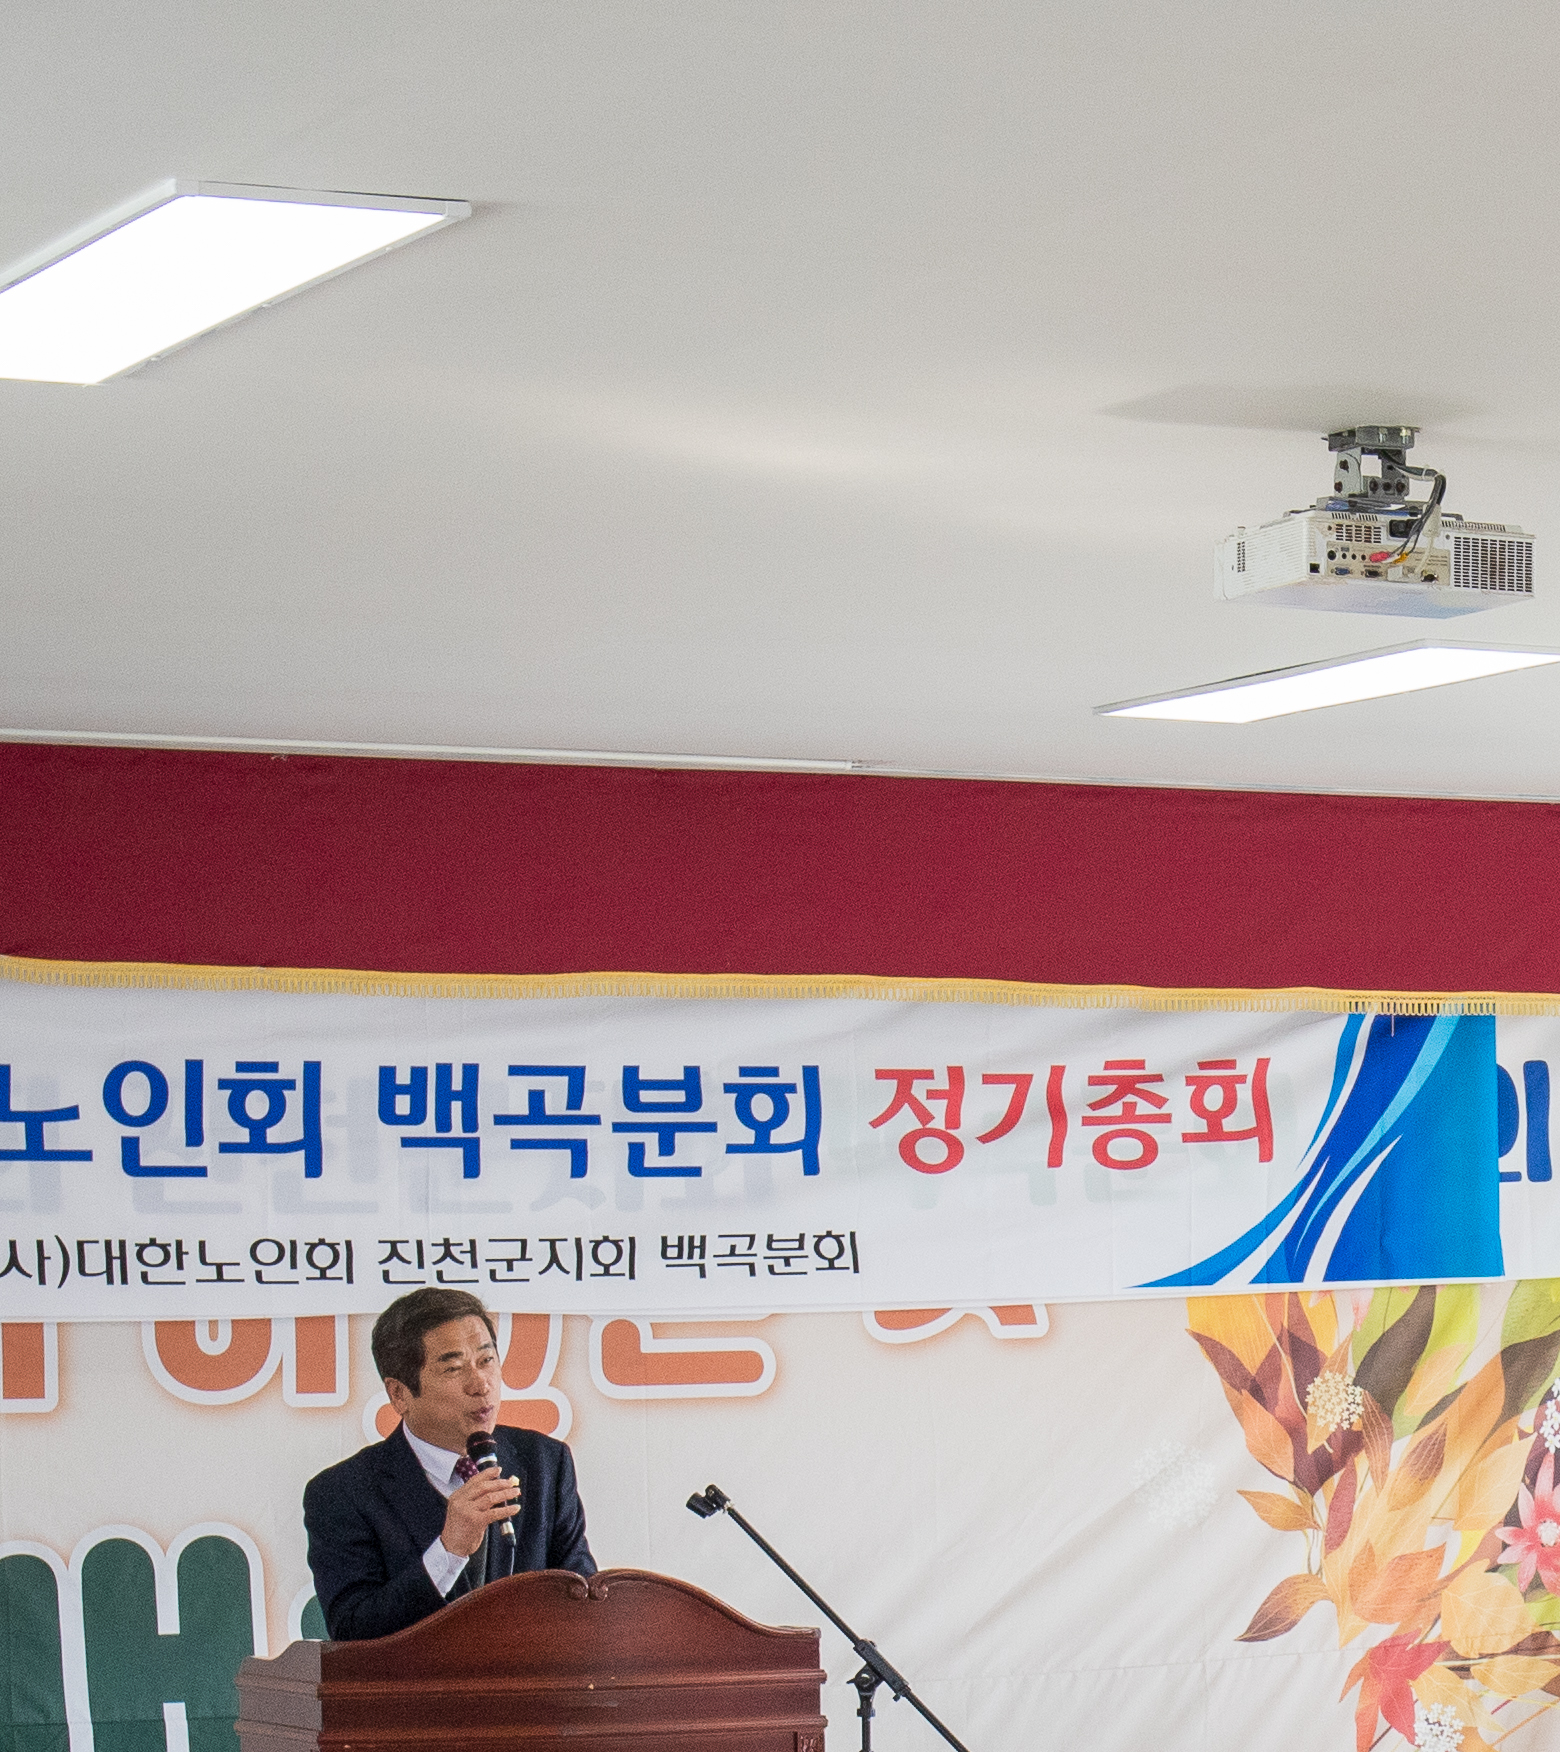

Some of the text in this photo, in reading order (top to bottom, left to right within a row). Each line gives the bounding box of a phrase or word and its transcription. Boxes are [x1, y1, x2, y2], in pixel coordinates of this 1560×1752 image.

[376, 1062, 822, 1179] 백곡분회
[869, 1057, 1275, 1175] 정기총회
[376, 1235, 637, 1286] 진천군지회
[659, 1229, 861, 1280] 백곡분회
